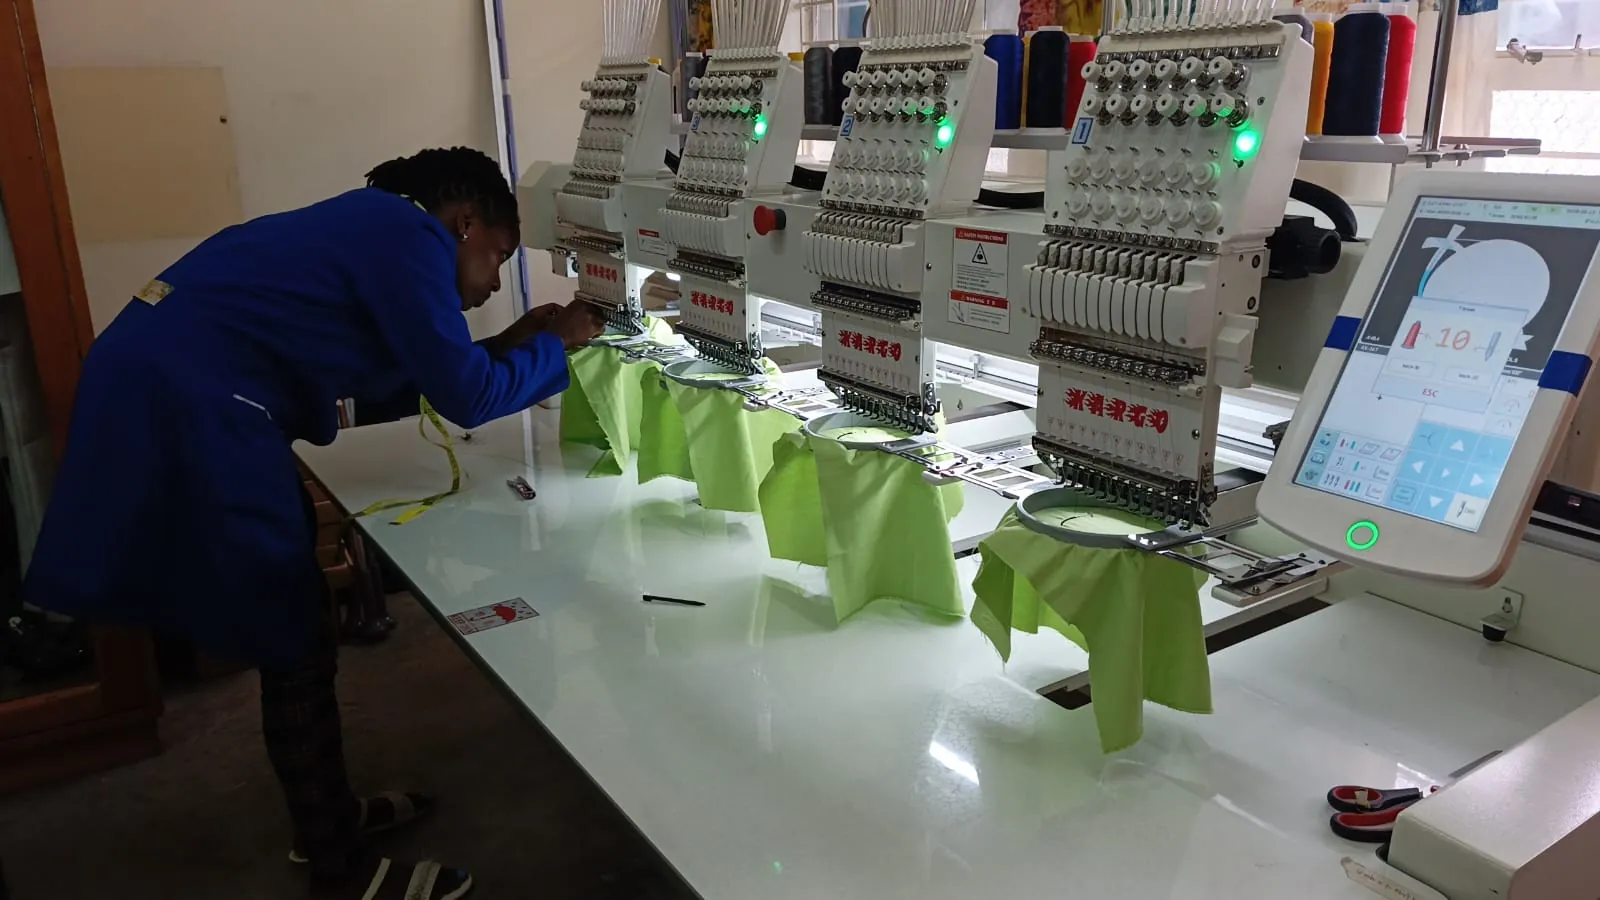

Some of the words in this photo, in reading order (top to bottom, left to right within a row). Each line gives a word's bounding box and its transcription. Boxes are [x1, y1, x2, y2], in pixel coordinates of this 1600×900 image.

[1435, 327, 1472, 350] 10
[1422, 388, 1439, 398] ESC
[1064, 387, 1169, 434] KARGO
